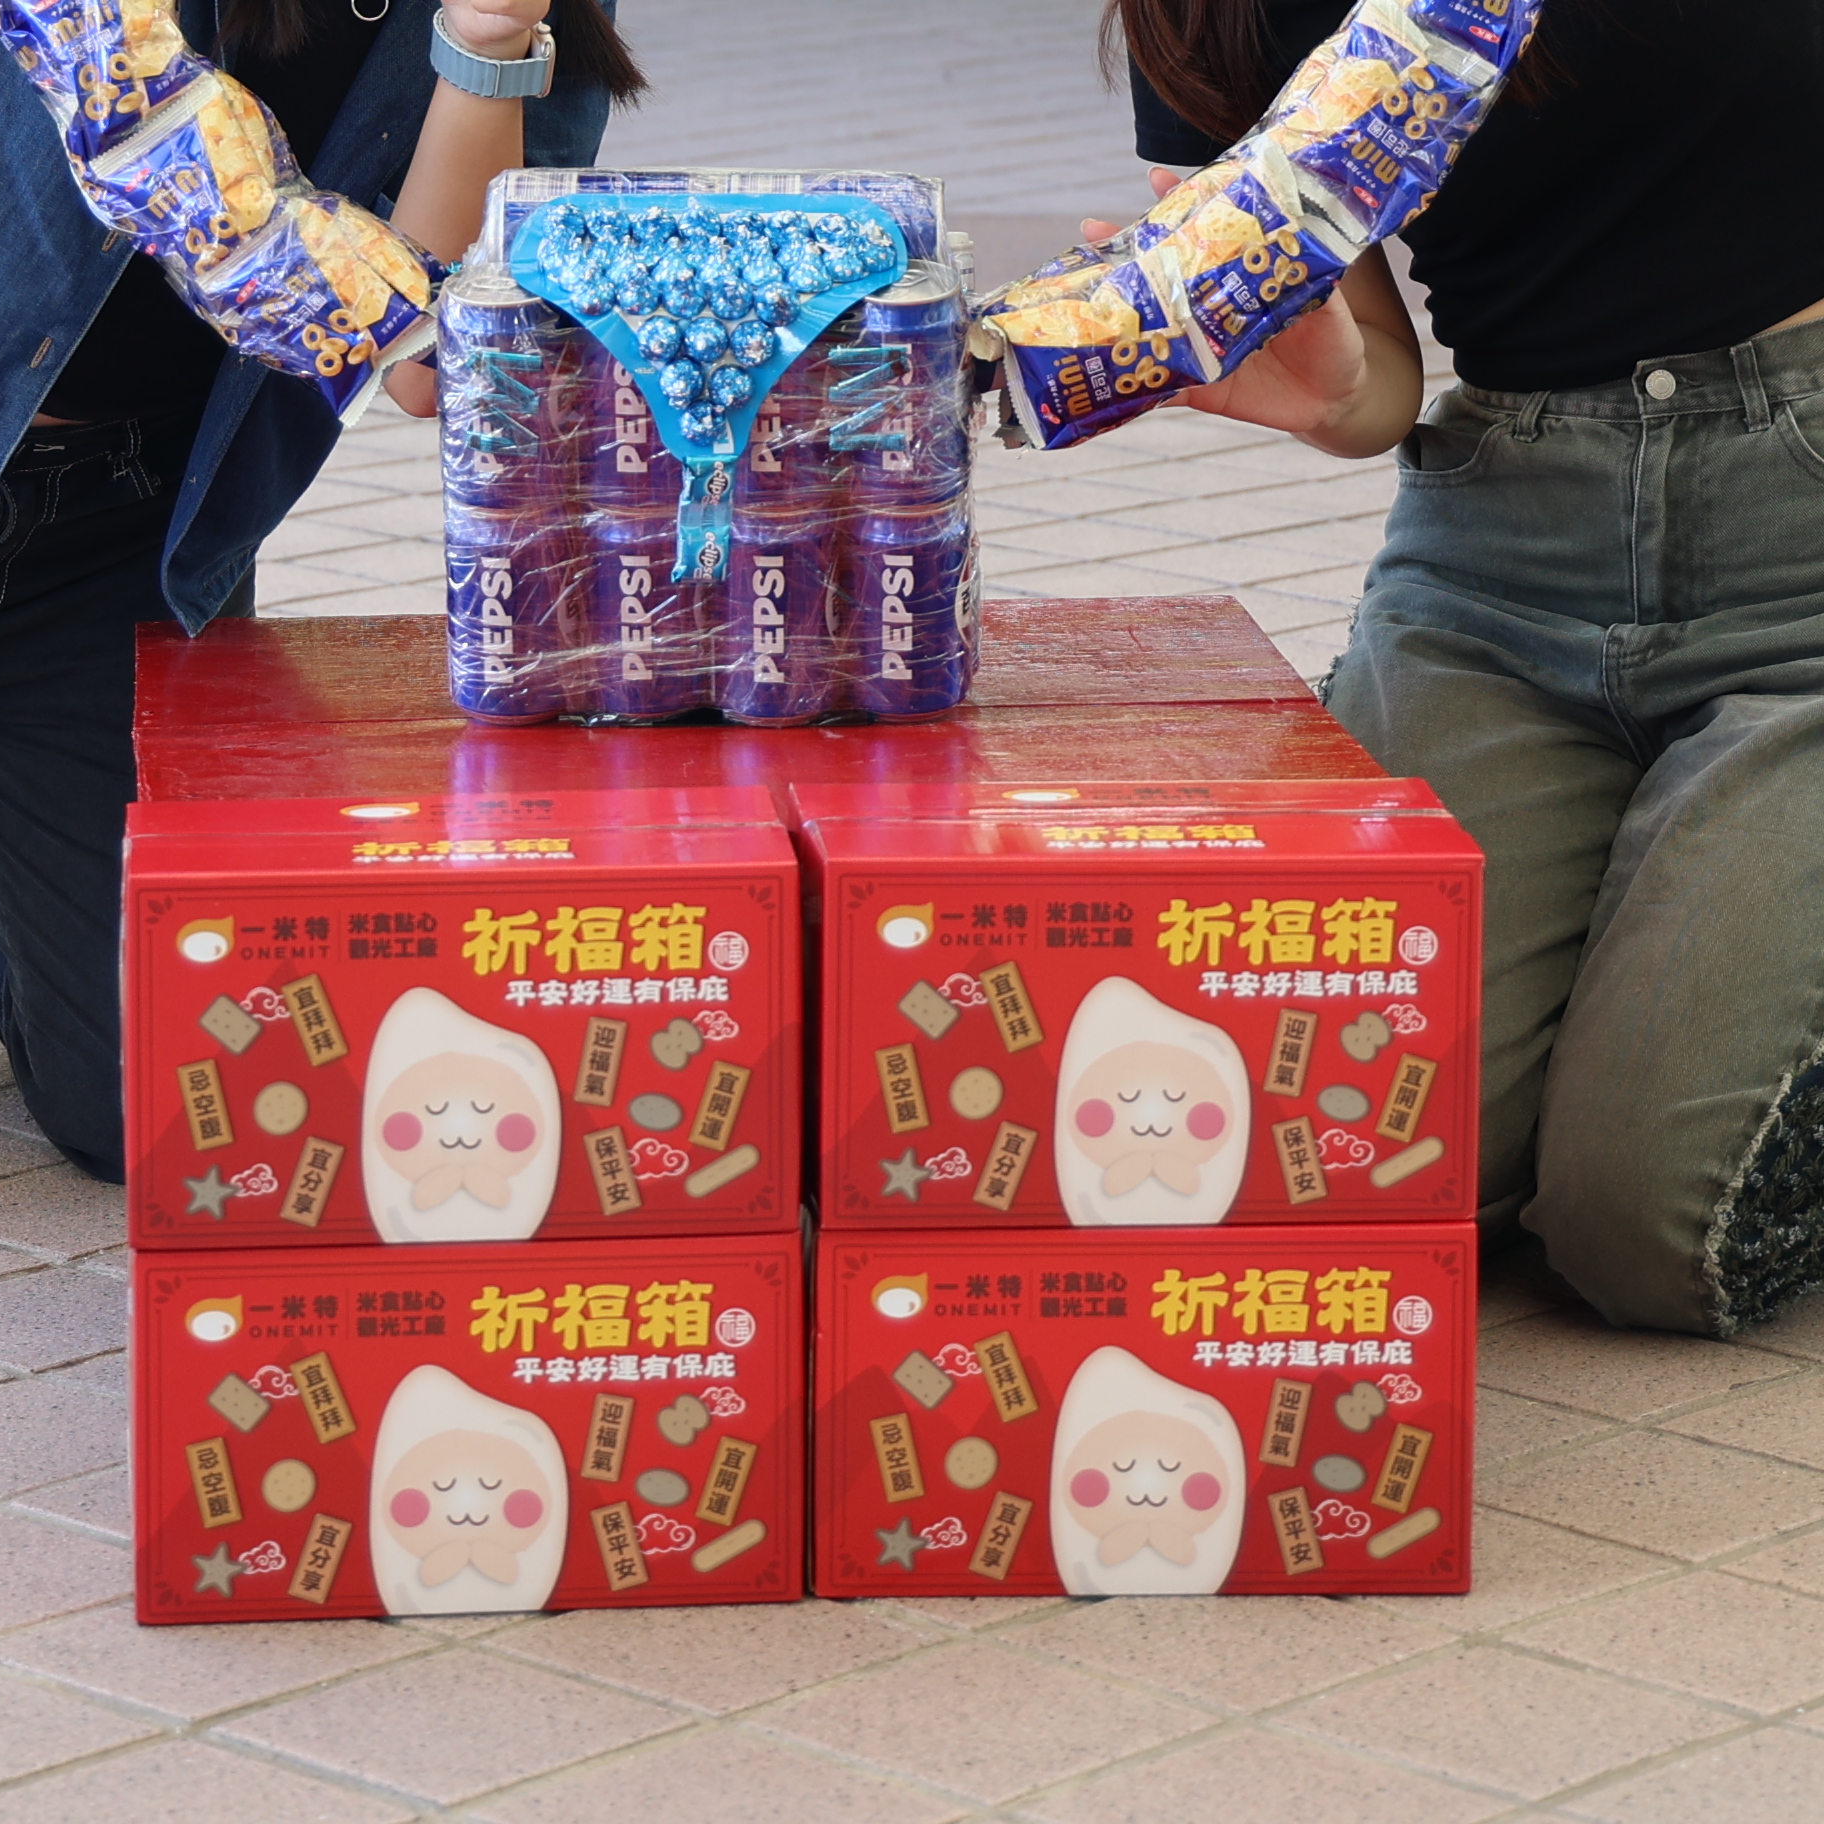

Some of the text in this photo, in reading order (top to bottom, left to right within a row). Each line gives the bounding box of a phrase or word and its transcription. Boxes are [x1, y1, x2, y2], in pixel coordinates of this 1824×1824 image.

[1340, 130, 1400, 183] mini
[1365, 117, 1412, 158] 起司圈
[1195, 279, 1246, 338] mini
[1220, 270, 1260, 316] 起司圈
[1053, 353, 1091, 415] mini
[1083, 355, 1112, 402] 起司圈
[710, 461, 727, 506] eclipse
[701, 531, 721, 580] eclipse
[481, 555, 514, 683] PEPSI
[620, 555, 653, 681] PEPSI
[752, 555, 786, 684] PEPSI
[881, 555, 914, 681] PEPSI
[352, 838, 571, 856] 祈福箱
[1042, 824, 1257, 841] 祈福箱
[241, 916, 330, 942] 一米特
[348, 913, 438, 935] 米食點心
[462, 903, 708, 975] 祈福箱
[941, 903, 1028, 928] 一米特
[941, 934, 1028, 946] ONEMIT
[1045, 902, 1133, 924] 米食點心
[1156, 897, 1398, 967] 祈福箱
[1406, 933, 1432, 957] 福
[240, 947, 330, 960] ONEMIT
[715, 938, 742, 964] 福
[1198, 971, 1418, 998] 平安好運有保庇
[292, 983, 337, 1057] 宜拜拜
[504, 976, 729, 1006] 平安好運有保庇
[989, 971, 1032, 1042] 宜拜拜
[583, 1025, 617, 1098] 迎福氣
[1272, 1017, 1308, 1089] 迎福氣
[188, 1068, 224, 1142] 忌空腹
[698, 1070, 740, 1143] 宜開運
[886, 1053, 920, 1124] 忌空腹
[1385, 1063, 1427, 1135] 宜開運
[292, 1147, 334, 1217] 宜分享
[594, 1135, 630, 1206] 保平安
[983, 1130, 1027, 1201] 宜分享
[1283, 1124, 1316, 1195] 保平安
[250, 1296, 338, 1319] 一米特
[357, 1291, 446, 1313] 米食點心
[470, 1280, 715, 1353] 祈福箱
[935, 1276, 1022, 1298] 一米特
[935, 1304, 1022, 1316] ONEMIT
[1040, 1271, 1128, 1294] 米食點心
[1150, 1267, 1392, 1336] 祈福箱
[1400, 1303, 1426, 1328] 福
[250, 1325, 338, 1337] ONEMIT
[723, 1316, 749, 1342] 福
[1193, 1341, 1413, 1367] 平安好運有保庇
[300, 1361, 344, 1433] 宜拜拜
[512, 1354, 736, 1384] 平安好運有保庇
[984, 1341, 1027, 1410] 宜拜拜
[590, 1402, 625, 1475] 迎福氣
[1267, 1386, 1302, 1458] 迎福氣
[196, 1447, 231, 1518] 忌空腹
[705, 1447, 746, 1518] 宜開運
[880, 1422, 916, 1493] 忌空腹
[1382, 1433, 1423, 1503] 宜開運
[299, 1523, 341, 1594] 宜分享
[601, 1511, 636, 1580] 保平安
[979, 1501, 1021, 1569] 宜分享
[1278, 1496, 1313, 1565] 保平安
